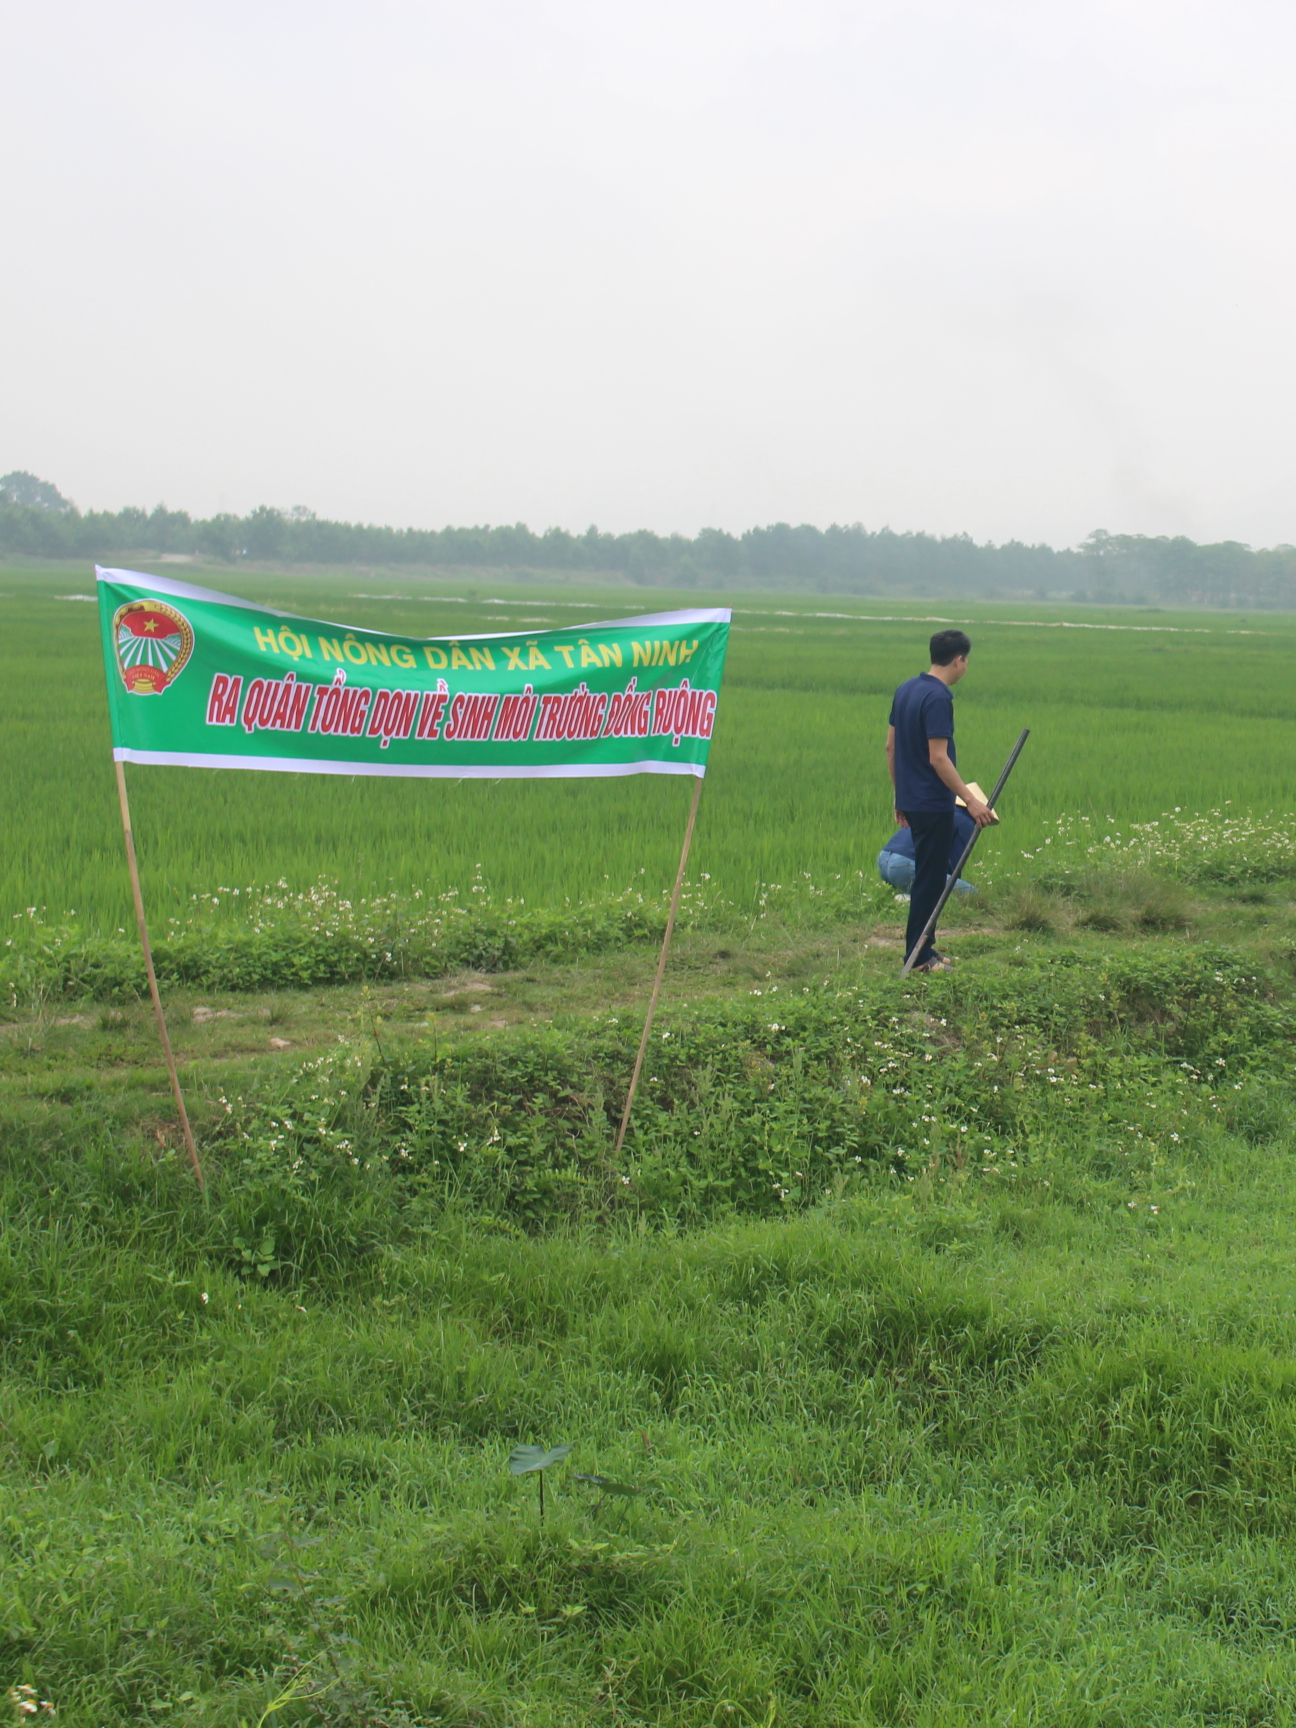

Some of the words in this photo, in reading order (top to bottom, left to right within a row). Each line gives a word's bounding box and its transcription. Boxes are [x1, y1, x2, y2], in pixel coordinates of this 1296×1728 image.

[254, 625, 313, 661] HỘI
[318, 633, 417, 670] NÔNG
[423, 640, 497, 670] DÂN
[501, 640, 552, 670] XÃ
[554, 638, 623, 669] TÂN
[630, 640, 699, 667] NINH
[206, 673, 243, 726] RA
[241, 672, 313, 733] QUÂN
[308, 668, 372, 737] TỔNG
[366, 691, 420, 748] DỌN
[444, 692, 501, 741] SINH
[492, 683, 539, 741] MÔI
[533, 682, 608, 741] TRƯỜNG
[651, 678, 718, 747] RUỘNG
